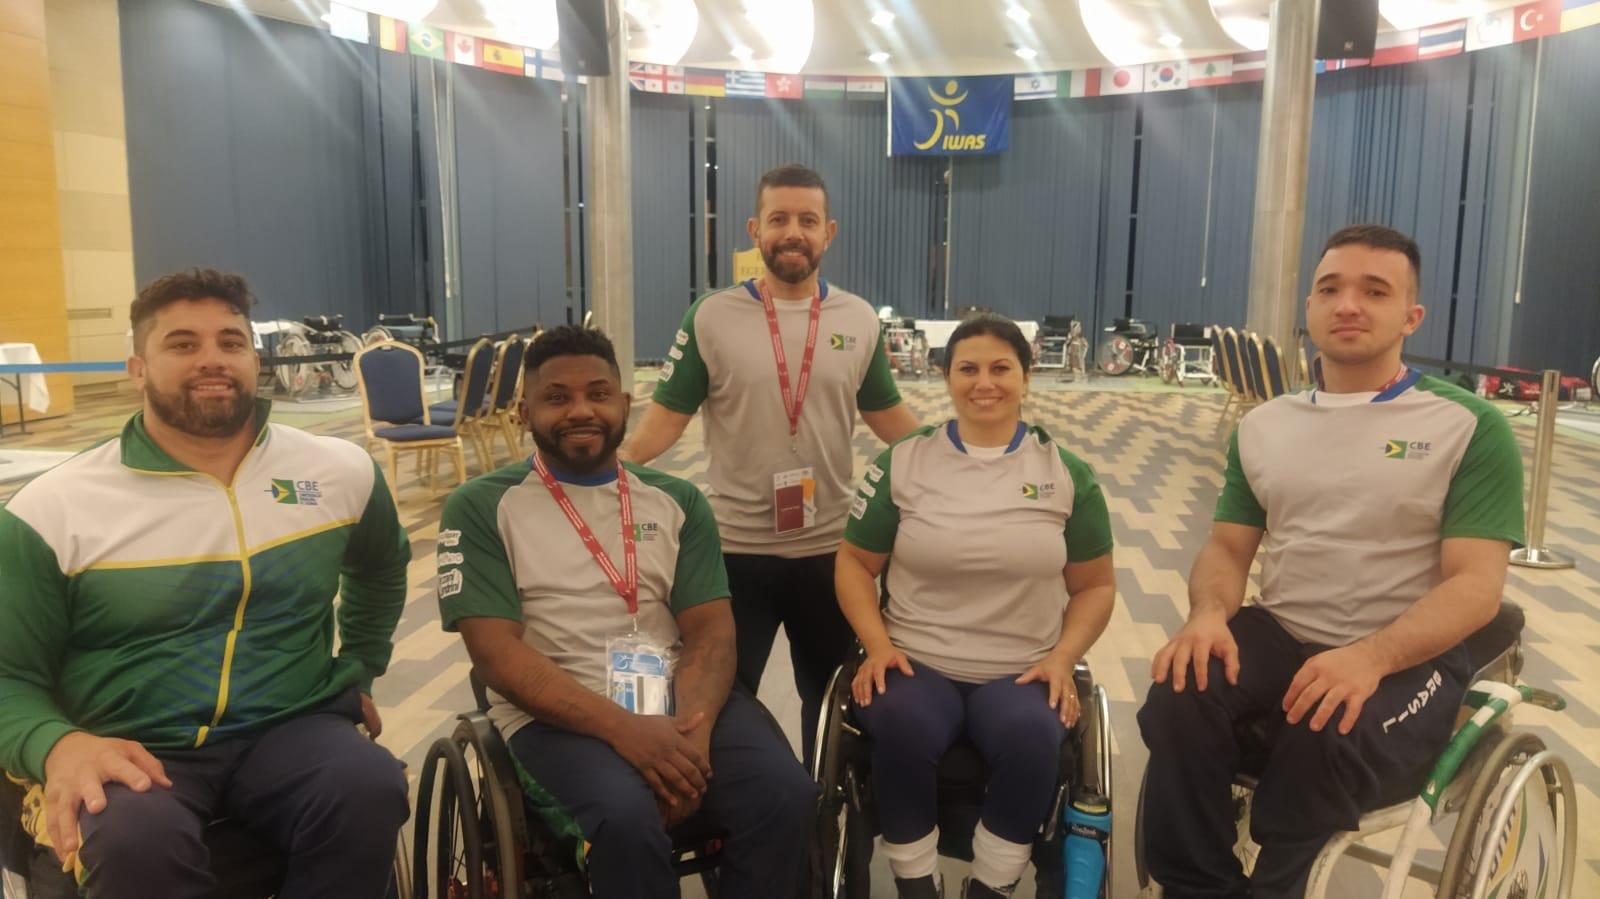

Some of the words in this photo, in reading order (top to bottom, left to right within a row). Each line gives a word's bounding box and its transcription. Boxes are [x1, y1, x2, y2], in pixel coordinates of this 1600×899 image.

[942, 134, 986, 150] IWAS
[1409, 441, 1432, 451] CBE
[296, 480, 320, 491] CBE
[641, 522, 659, 532] CBE
[1382, 670, 1442, 734] BRASIL
